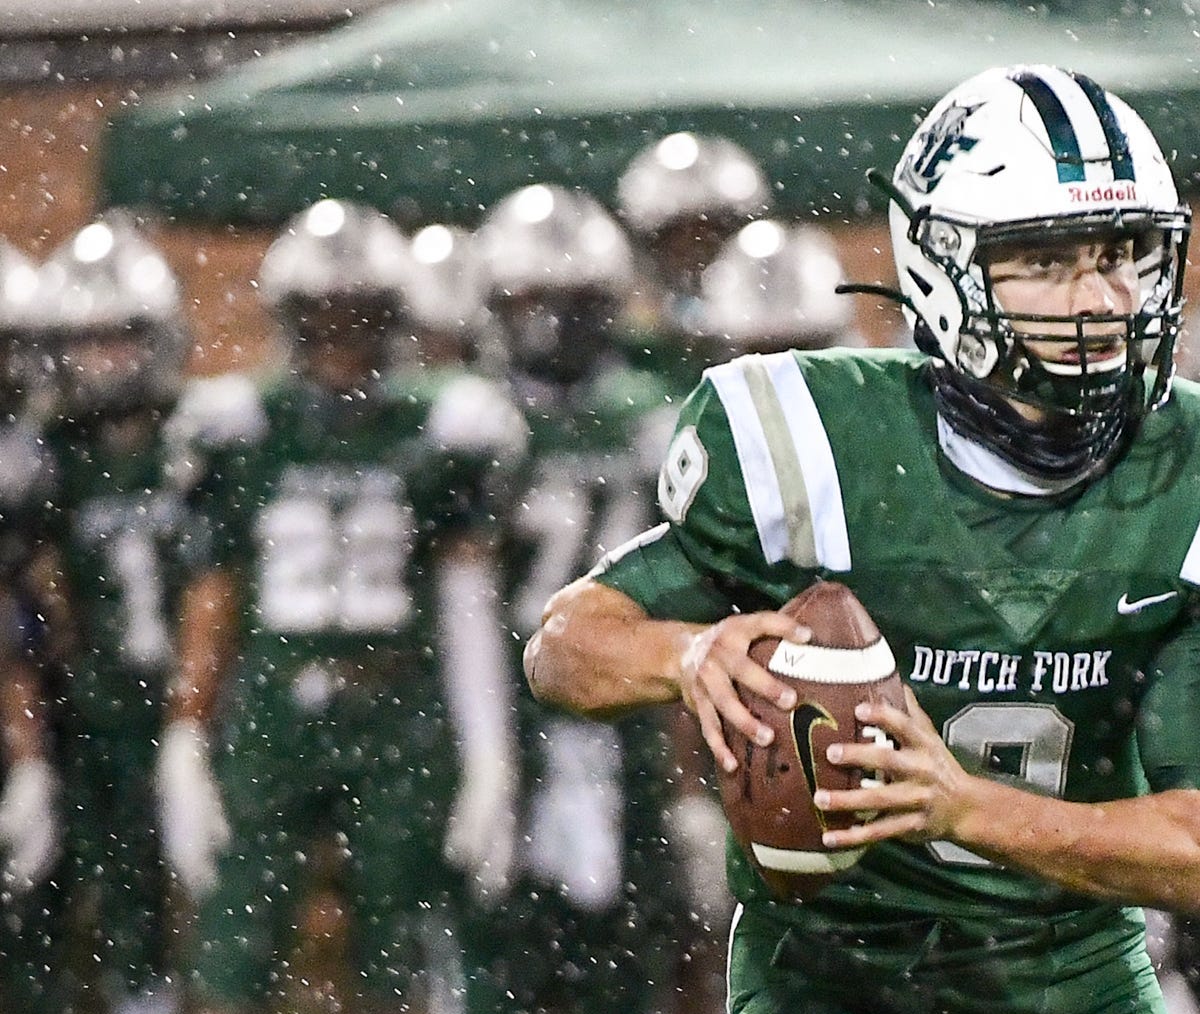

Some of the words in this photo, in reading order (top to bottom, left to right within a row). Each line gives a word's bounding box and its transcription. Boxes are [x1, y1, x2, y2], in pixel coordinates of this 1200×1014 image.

[1068, 184, 1137, 202] Riddell
[909, 645, 1022, 692] DUTCH
[1031, 650, 1112, 694] FORK
